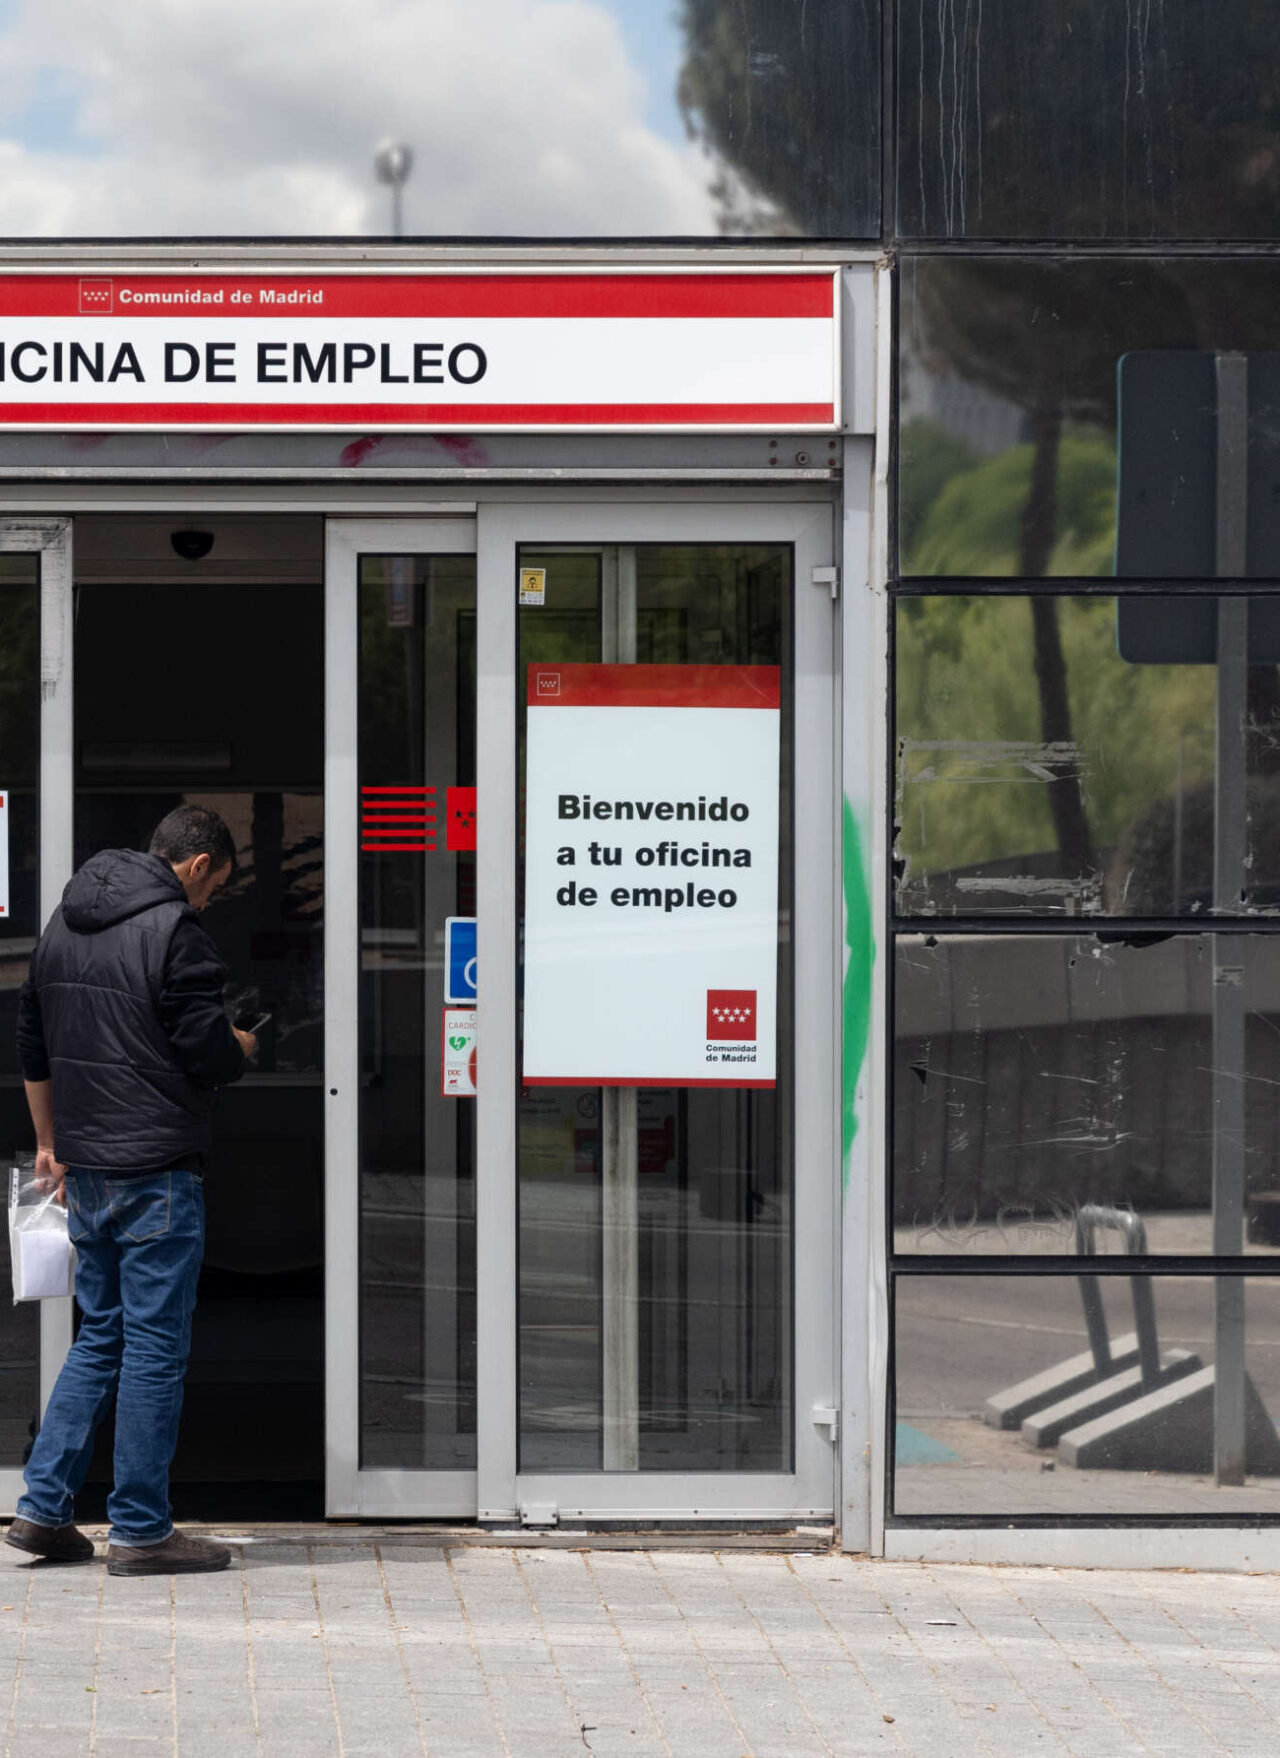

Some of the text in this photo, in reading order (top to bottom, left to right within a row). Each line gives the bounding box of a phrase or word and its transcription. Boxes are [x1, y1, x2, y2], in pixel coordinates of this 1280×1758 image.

[119, 289, 324, 304] Comunidad de Madrid
[164, 342, 237, 383] DE
[256, 342, 488, 384] EMPLEO
[558, 794, 750, 822] Bienvenido
[556, 841, 752, 868] a tu oficina
[556, 880, 738, 913] de empleo
[706, 1044, 757, 1052] Comunidad
[706, 1054, 757, 1062] de Madrid
